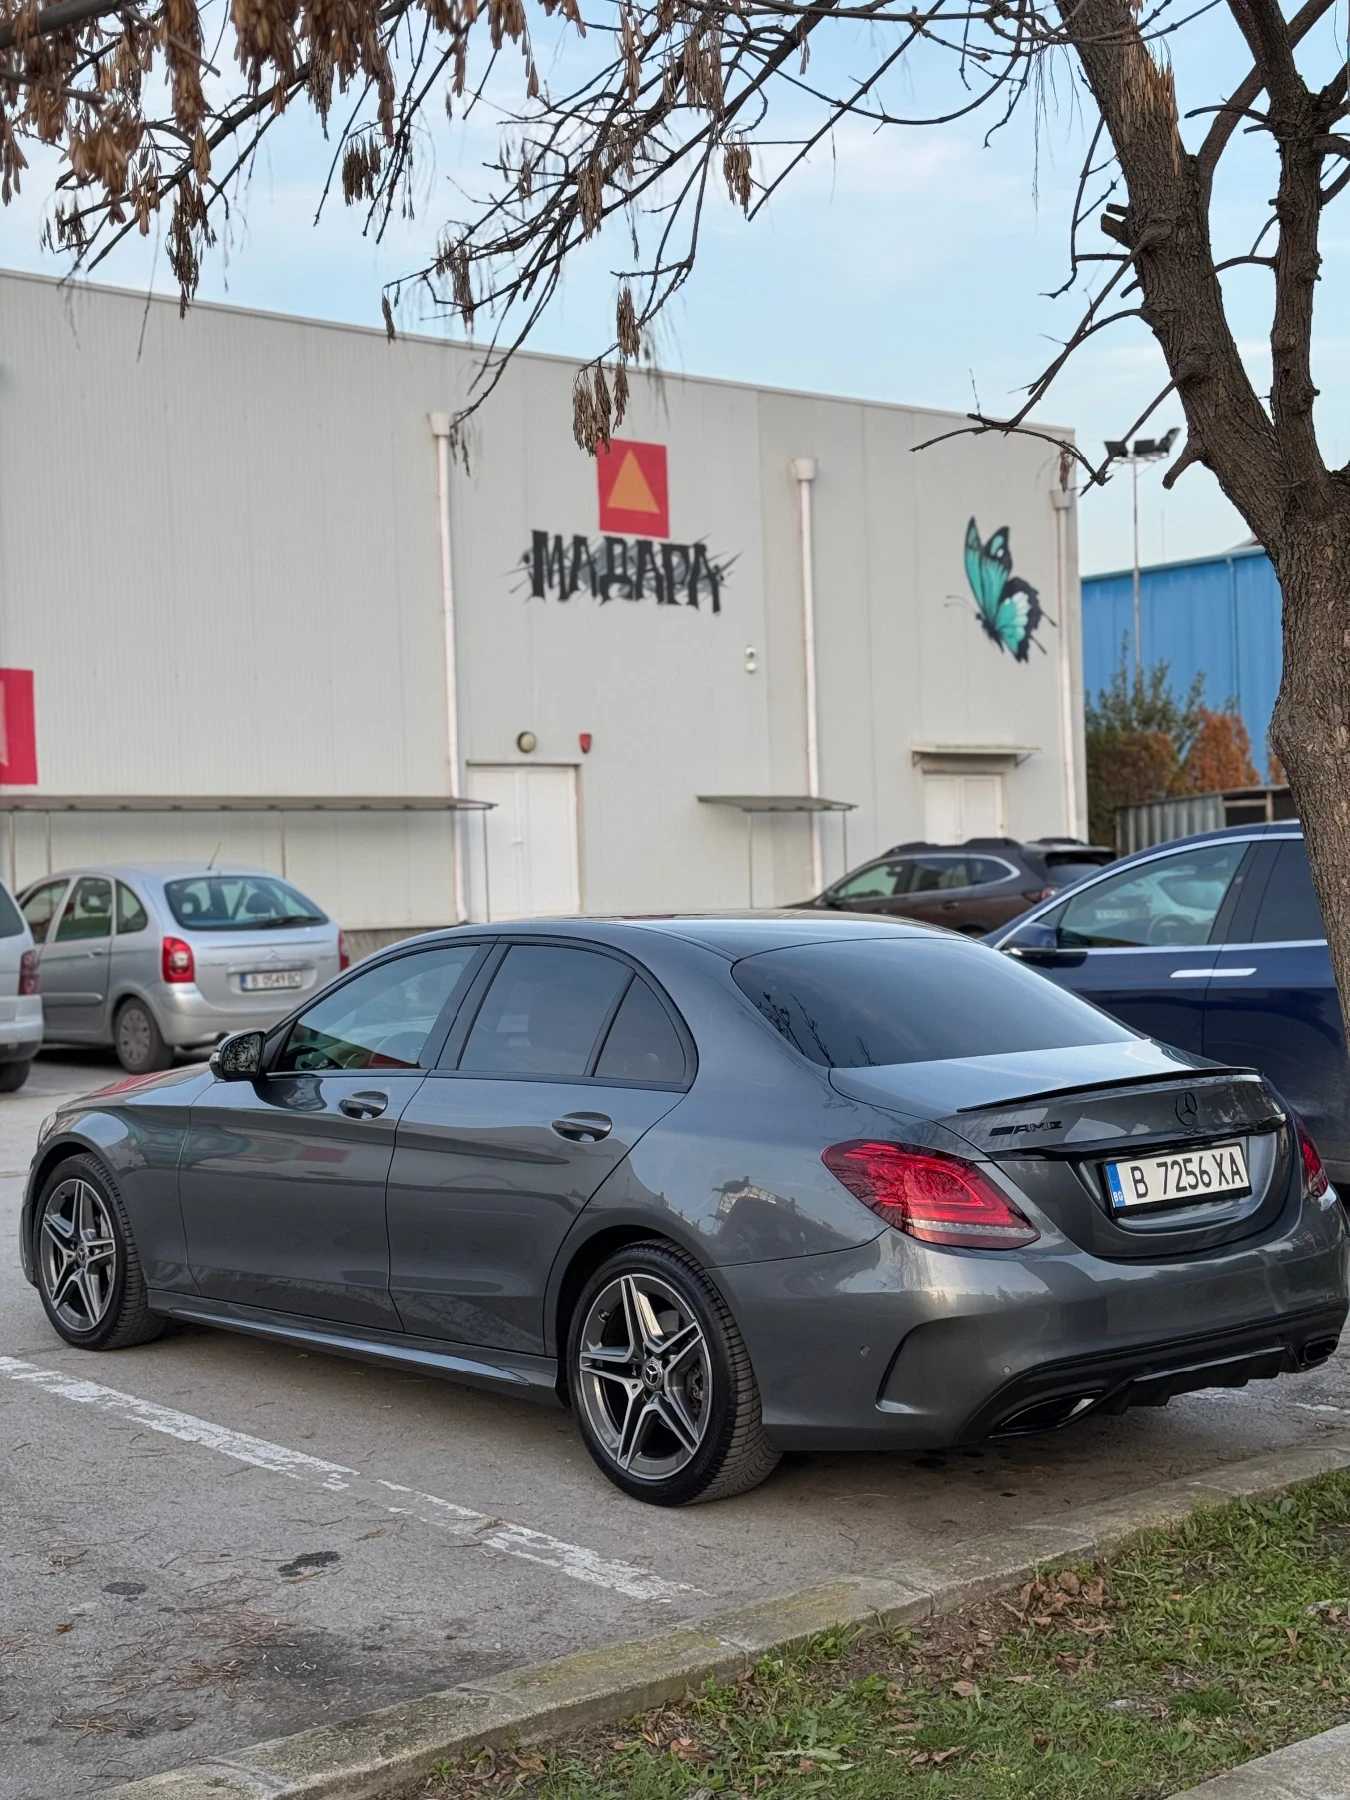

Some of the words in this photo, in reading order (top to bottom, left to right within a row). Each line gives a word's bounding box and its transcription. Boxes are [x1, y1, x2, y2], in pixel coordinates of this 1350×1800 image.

[1012, 1120, 1064, 1134] AMG
[1129, 1165, 1149, 1199] B
[1155, 1155, 1212, 1195] 7256
[1113, 1191, 1124, 1202] BG
